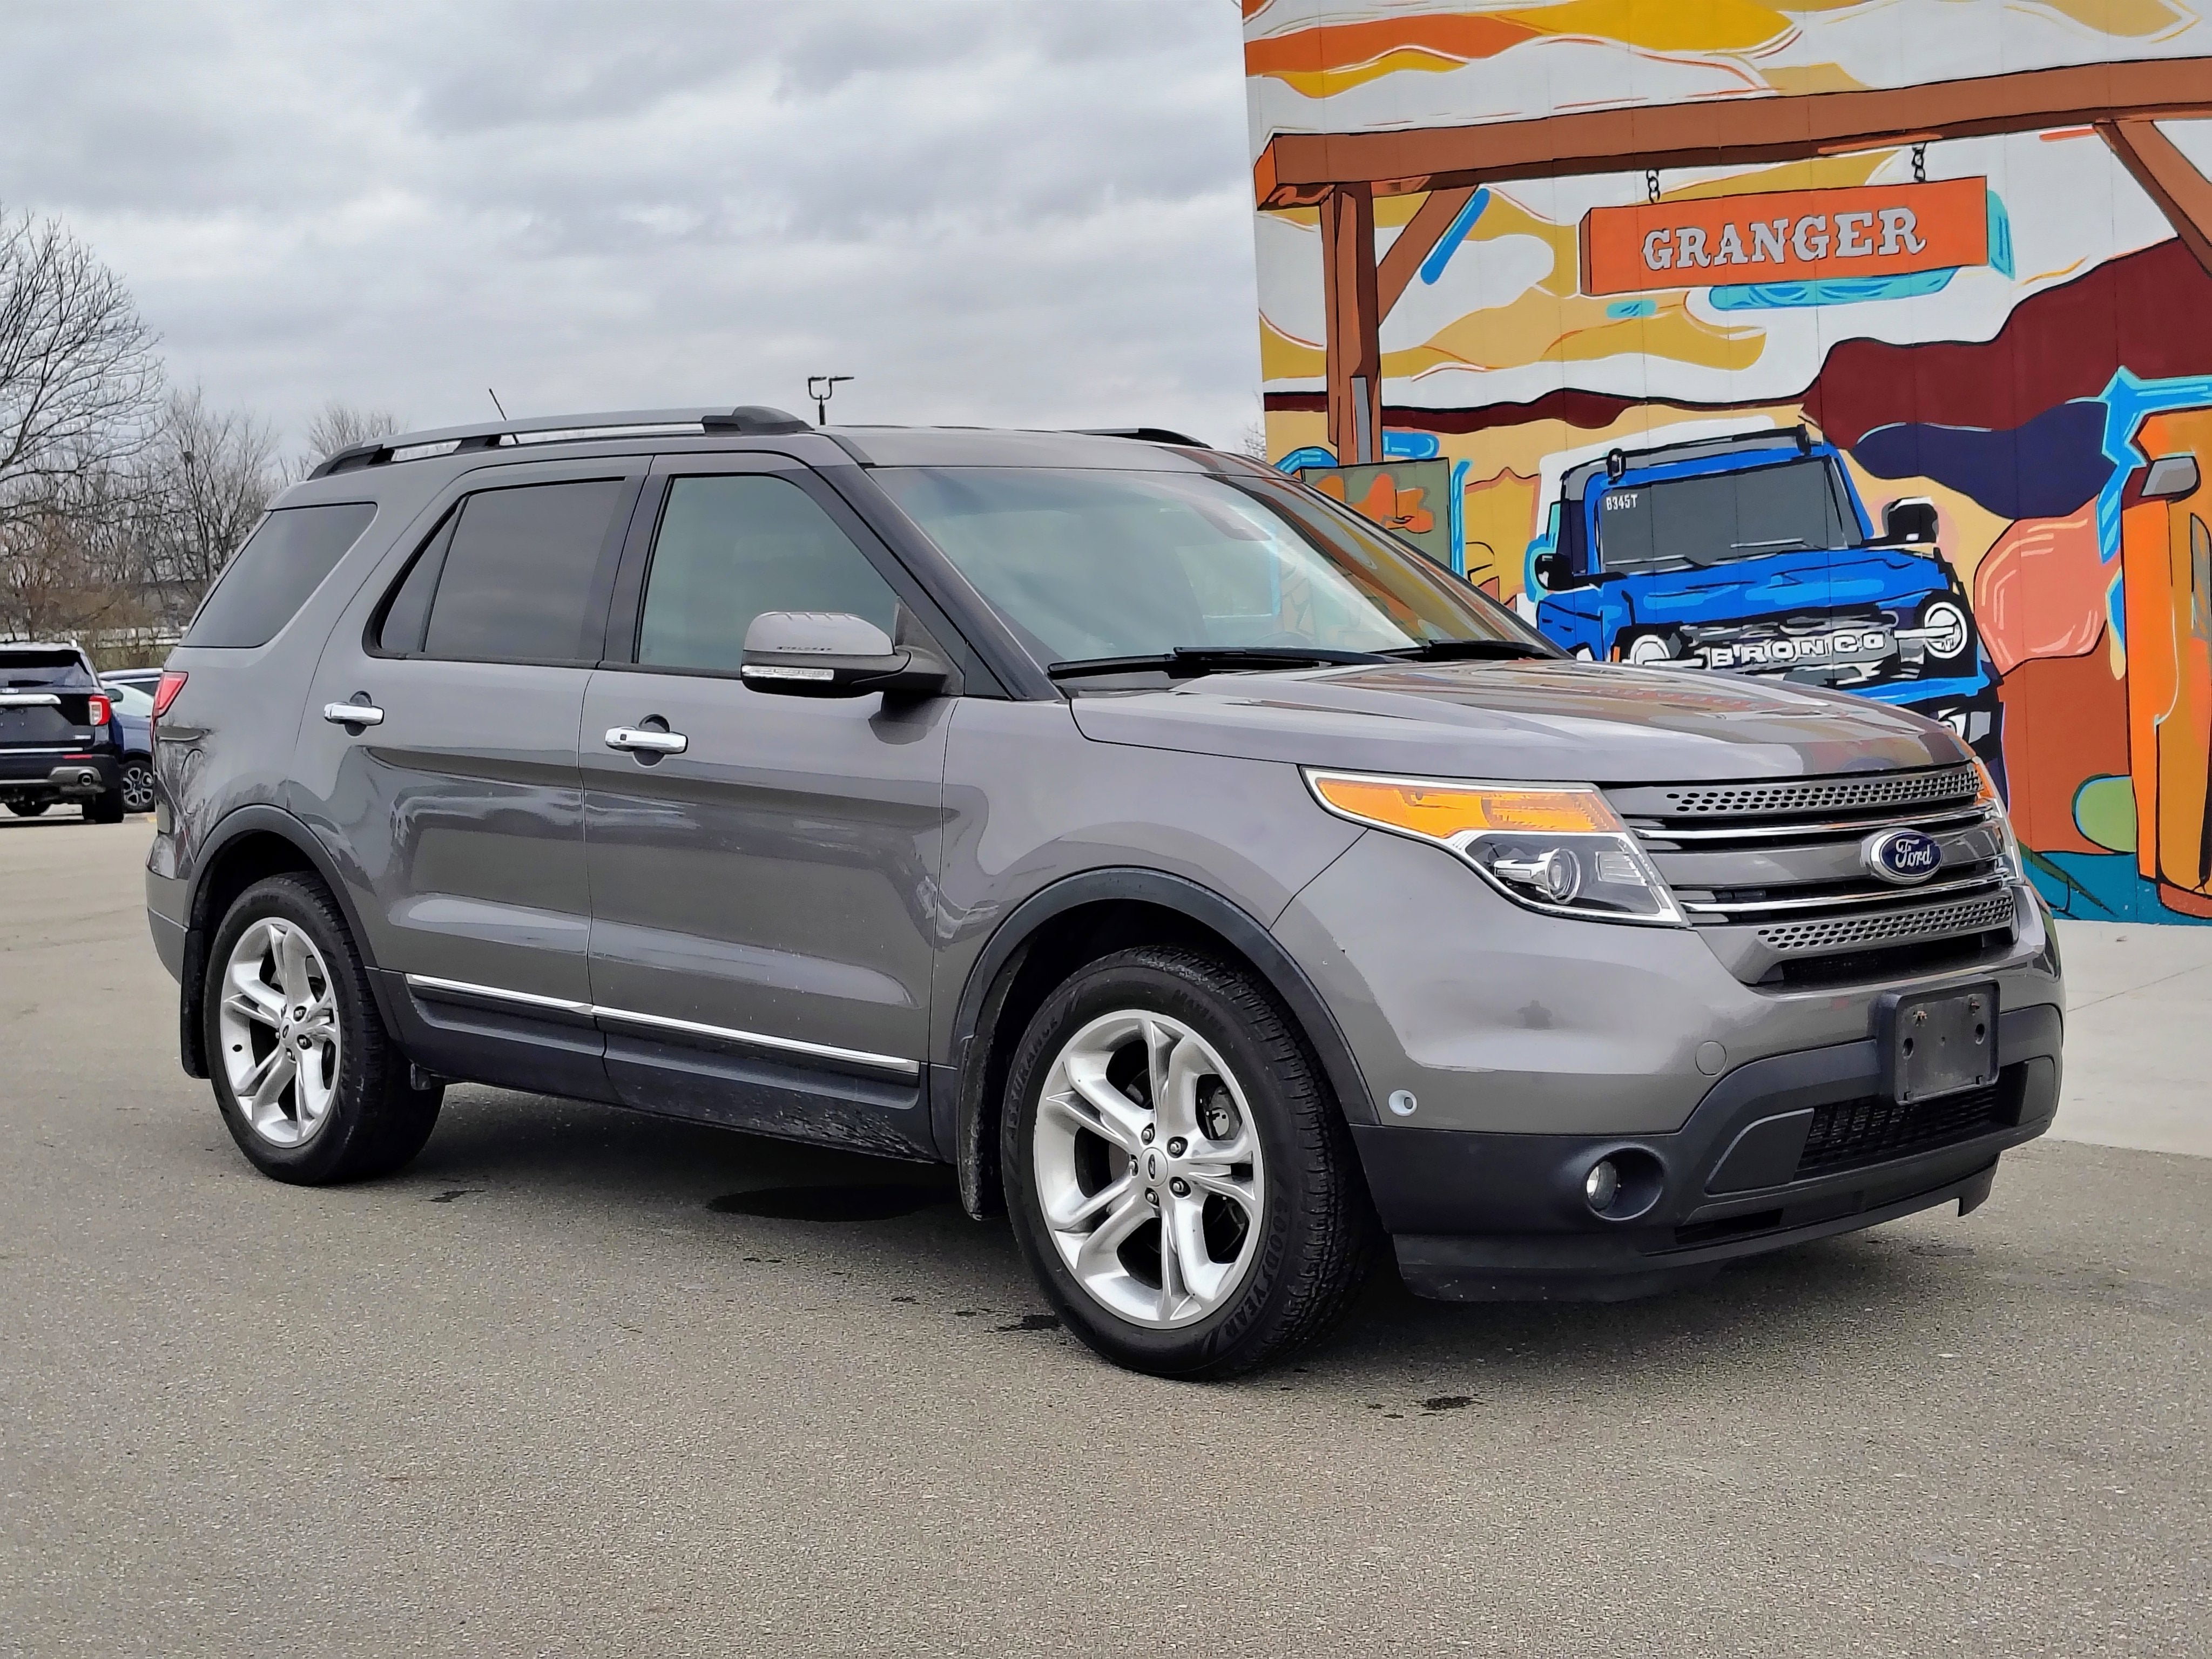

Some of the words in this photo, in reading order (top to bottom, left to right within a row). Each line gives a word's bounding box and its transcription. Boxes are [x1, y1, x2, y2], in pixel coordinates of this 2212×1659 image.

[1642, 207, 1927, 271] GRANGER
[1606, 494, 1638, 511] B345T
[1711, 631, 1886, 670] BRONCO
[1895, 839, 1933, 868] Ford
[1224, 1196, 1289, 1338] GOODYEAR
